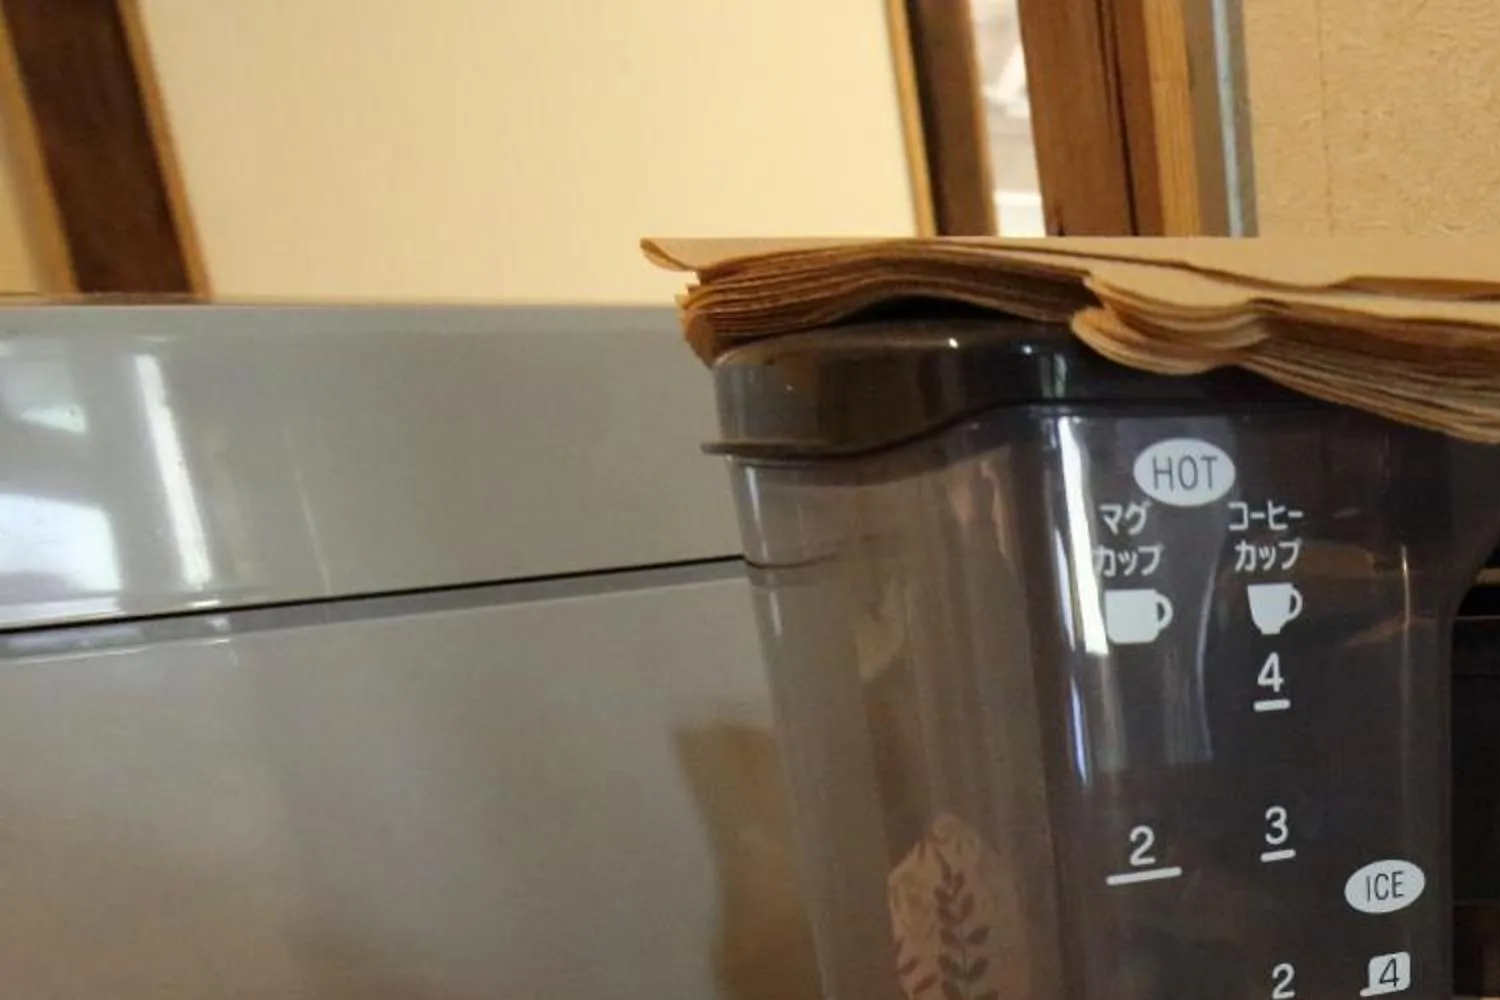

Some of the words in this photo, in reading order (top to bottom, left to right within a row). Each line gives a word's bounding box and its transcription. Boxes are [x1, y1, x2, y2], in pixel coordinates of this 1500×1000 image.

[1151, 455, 1218, 492] HOT
[1100, 500, 1153, 535] マグ
[1228, 500, 1304, 532] コーヒー
[1096, 544, 1165, 578] カップ
[1234, 538, 1304, 573] カップ
[1257, 651, 1285, 693] 4
[1264, 805, 1290, 845] 3
[1129, 825, 1157, 867] 2
[1365, 871, 1405, 902] ICE
[1271, 962, 1296, 1000] 2
[1379, 957, 1401, 988] 4
